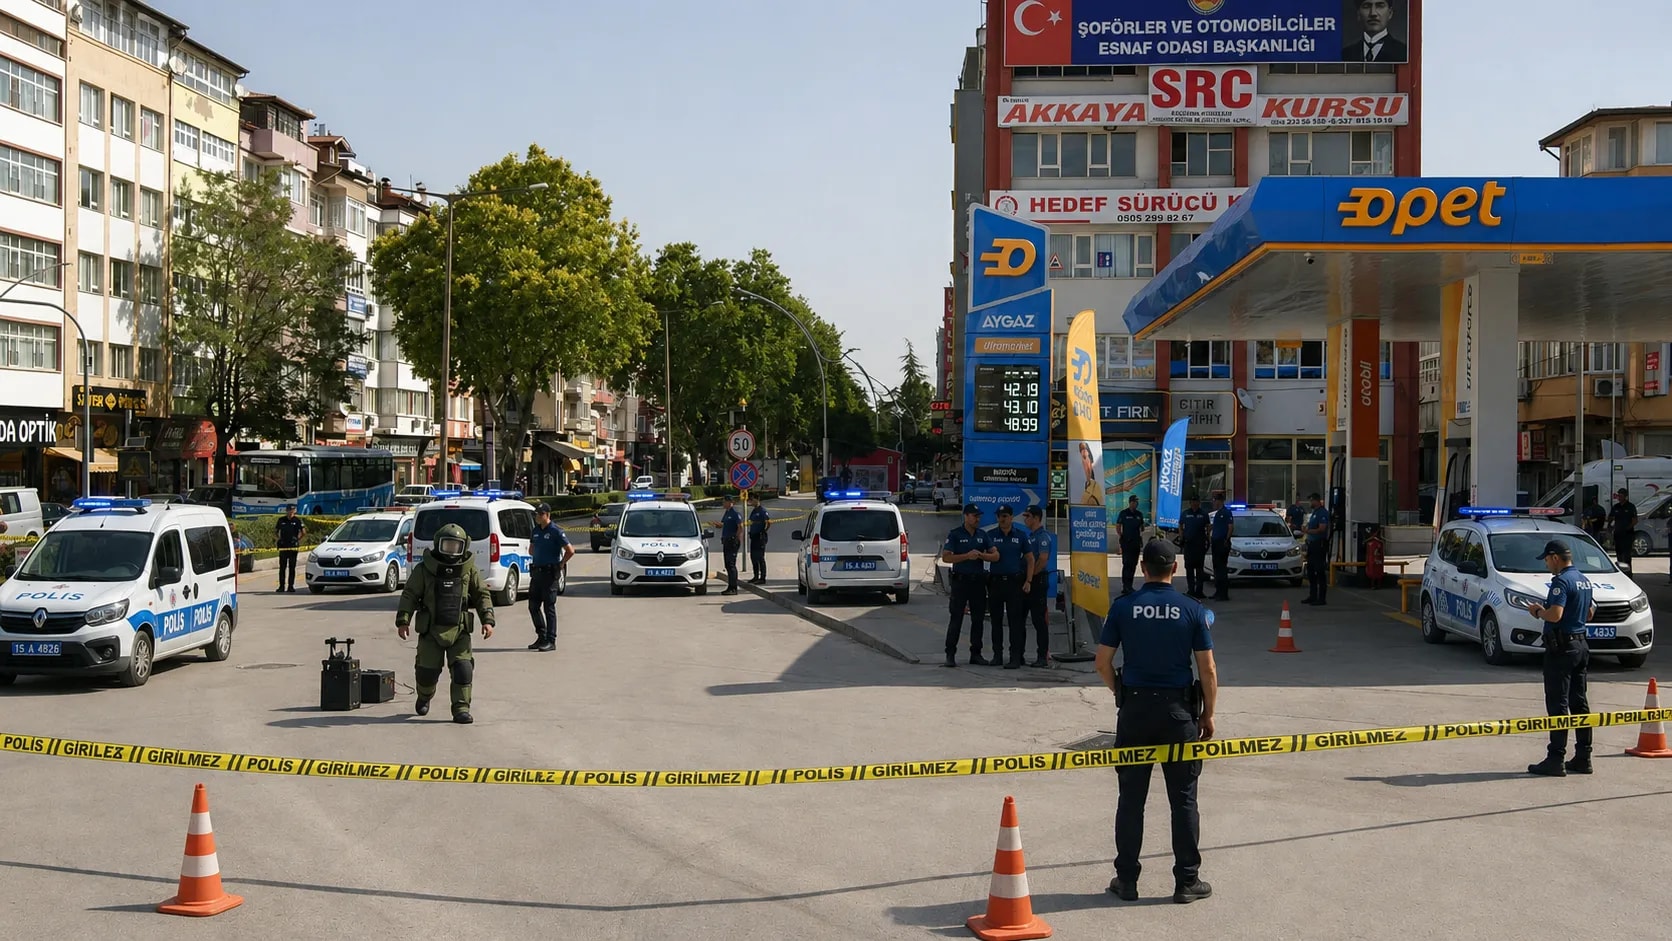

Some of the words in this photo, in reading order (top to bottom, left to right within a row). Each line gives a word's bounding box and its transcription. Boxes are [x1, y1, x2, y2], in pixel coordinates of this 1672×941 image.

[1078, 18, 1167, 38] ŞOFÖRLER
[1171, 20, 1192, 33] VE
[1197, 14, 1336, 33] OTOMOBİLCİLER
[1099, 41, 1152, 55] ESNAF
[1156, 40, 1208, 55] ODASI
[1213, 35, 1315, 56] BAŞKANLIĞI
[1151, 68, 1253, 109] SRC
[1002, 102, 1146, 123] AKKAYA
[1261, 96, 1404, 118] KURSU
[1030, 196, 1108, 213] HEDEF
[1117, 192, 1218, 212] SÜRÜCÜ
[1145, 214, 1163, 222] 299
[1181, 213, 1194, 221] 67
[982, 315, 1035, 328] AYGAZ
[18, 413, 57, 443] OPTİK
[1003, 417, 1039, 432] 48.99
[734, 438, 749, 451] 50
[1132, 603, 1181, 619] POLİS
[28, 643, 35, 653] A
[147, 748, 221, 768] GİRİLMEZ
[247, 757, 293, 772] POLİS
[316, 761, 391, 778] GİRİLMEZ
[418, 767, 469, 781] POLİS
[583, 771, 637, 784] POLİS
[664, 771, 741, 785] GİRİLMEZ
[793, 766, 845, 781] POLİS
[872, 761, 958, 777] GİRİLMEZ
[993, 754, 1046, 770] POLİS
[1071, 747, 1158, 766] GİRİLMEZ
[1314, 731, 1408, 748] GİRİLMEZ
